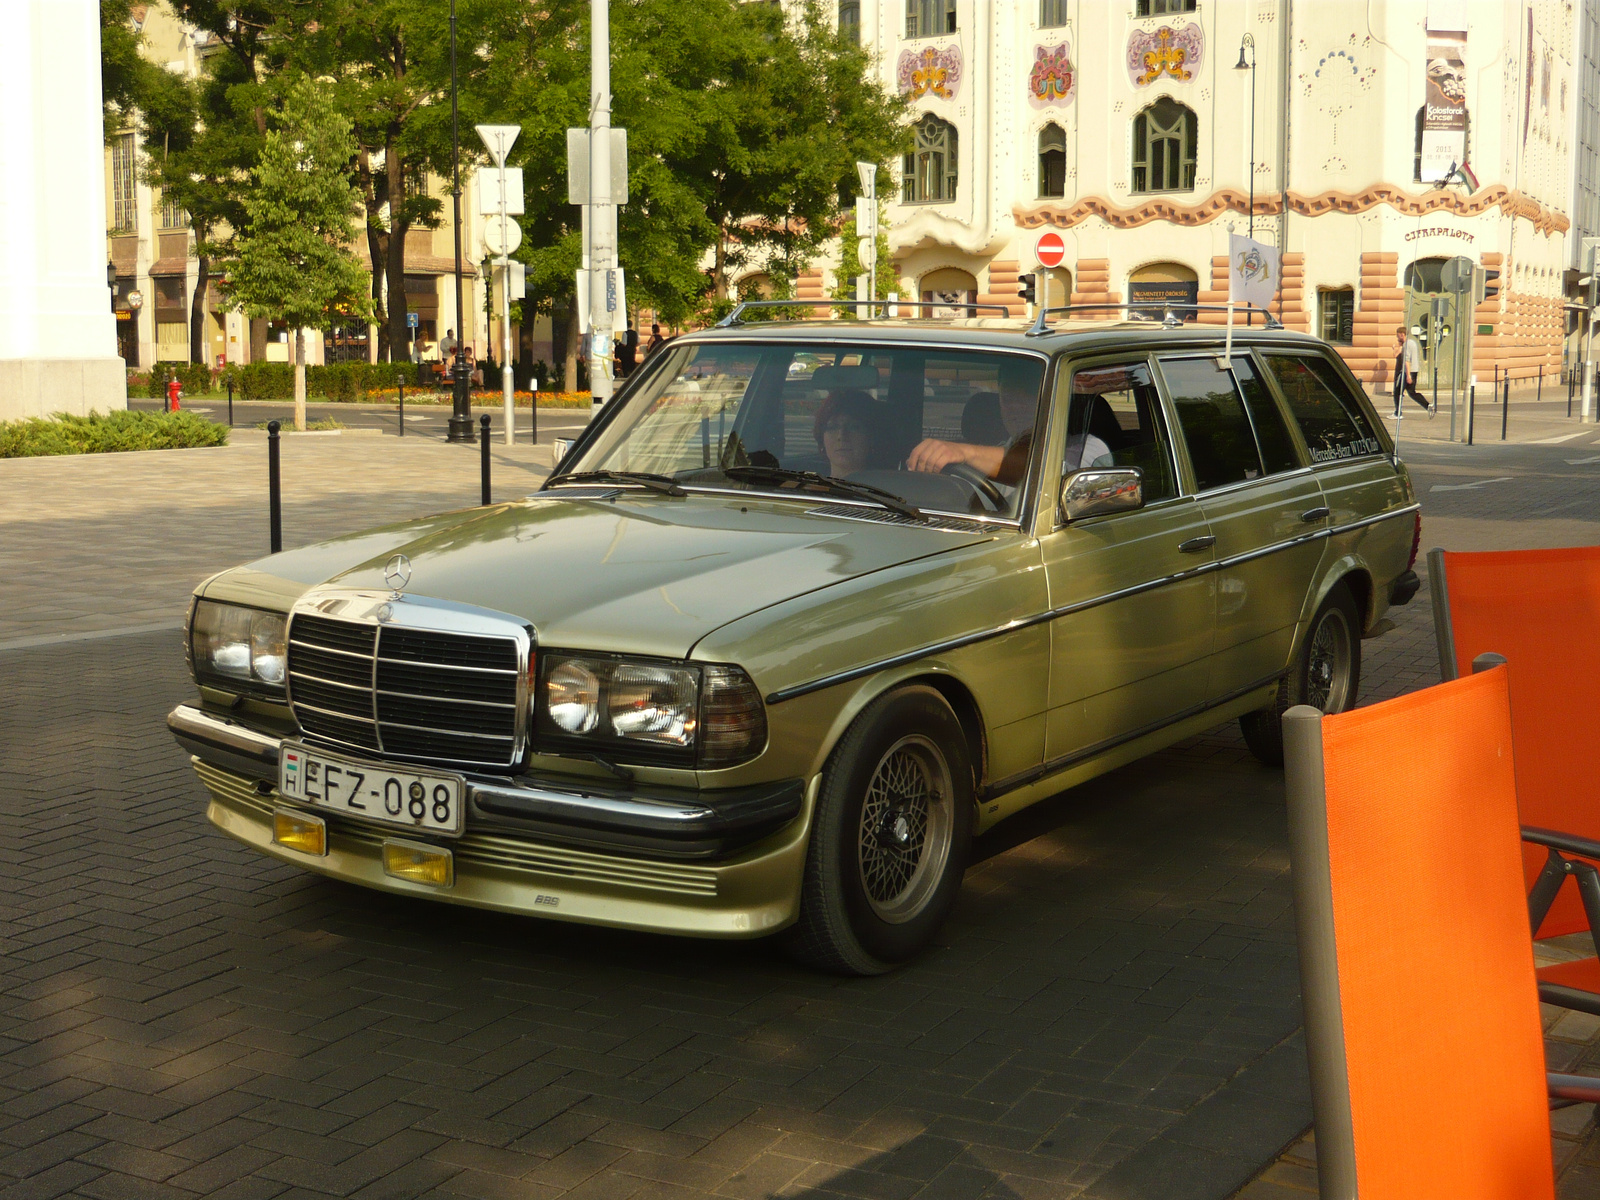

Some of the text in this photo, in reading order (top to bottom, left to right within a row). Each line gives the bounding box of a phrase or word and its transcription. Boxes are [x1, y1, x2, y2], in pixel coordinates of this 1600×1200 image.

[1404, 227, 1475, 244] CIFRAPALOTA
[1308, 443, 1351, 462] Mercedes-Benz
[1365, 437, 1379, 453] Club
[285, 759, 451, 823] H EFZ-088
[534, 894, 560, 906] BBS
